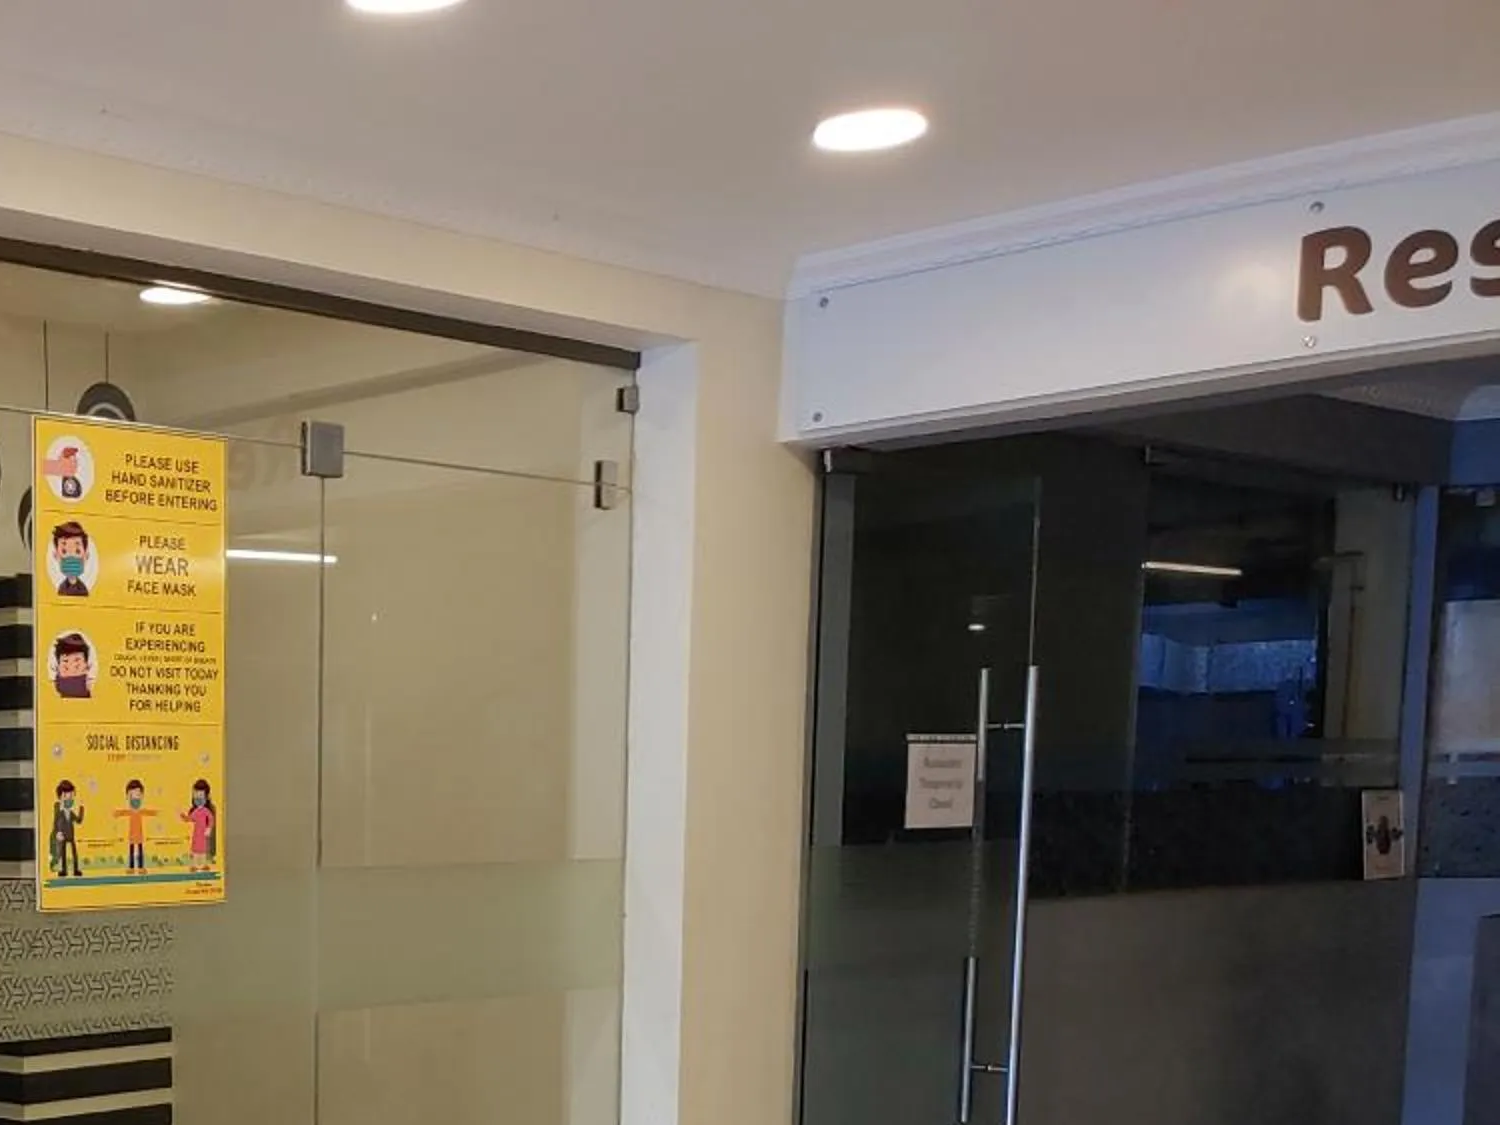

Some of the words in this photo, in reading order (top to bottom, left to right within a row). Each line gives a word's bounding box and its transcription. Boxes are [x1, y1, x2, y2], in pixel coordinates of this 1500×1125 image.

[125, 453, 172, 471] PLEASE
[175, 459, 199, 474] USE
[112, 472, 146, 487] HAND
[150, 475, 211, 493] SANITIZER
[105, 490, 155, 507] BEFORE
[158, 495, 218, 512] ENTERING
[139, 535, 186, 551] PLEASE
[135, 554, 189, 577] WEAR
[127, 580, 158, 595] FACE
[163, 582, 197, 597] MASK
[135, 621, 145, 633] IF
[149, 623, 171, 635] YOU
[174, 624, 196, 637] ARE
[125, 638, 205, 653] EXPERIENCING
[110, 665, 127, 677] DO
[130, 666, 151, 679] NOT
[155, 668, 181, 680] VISIT
[183, 668, 219, 681] TODAY
[126, 683, 181, 696] THANKING
[184, 684, 207, 697] YOU
[130, 700, 152, 712] FOR
[155, 700, 201, 713] HELPING
[87, 735, 120, 751] SOCIAL
[126, 735, 180, 751] DISTANCING
